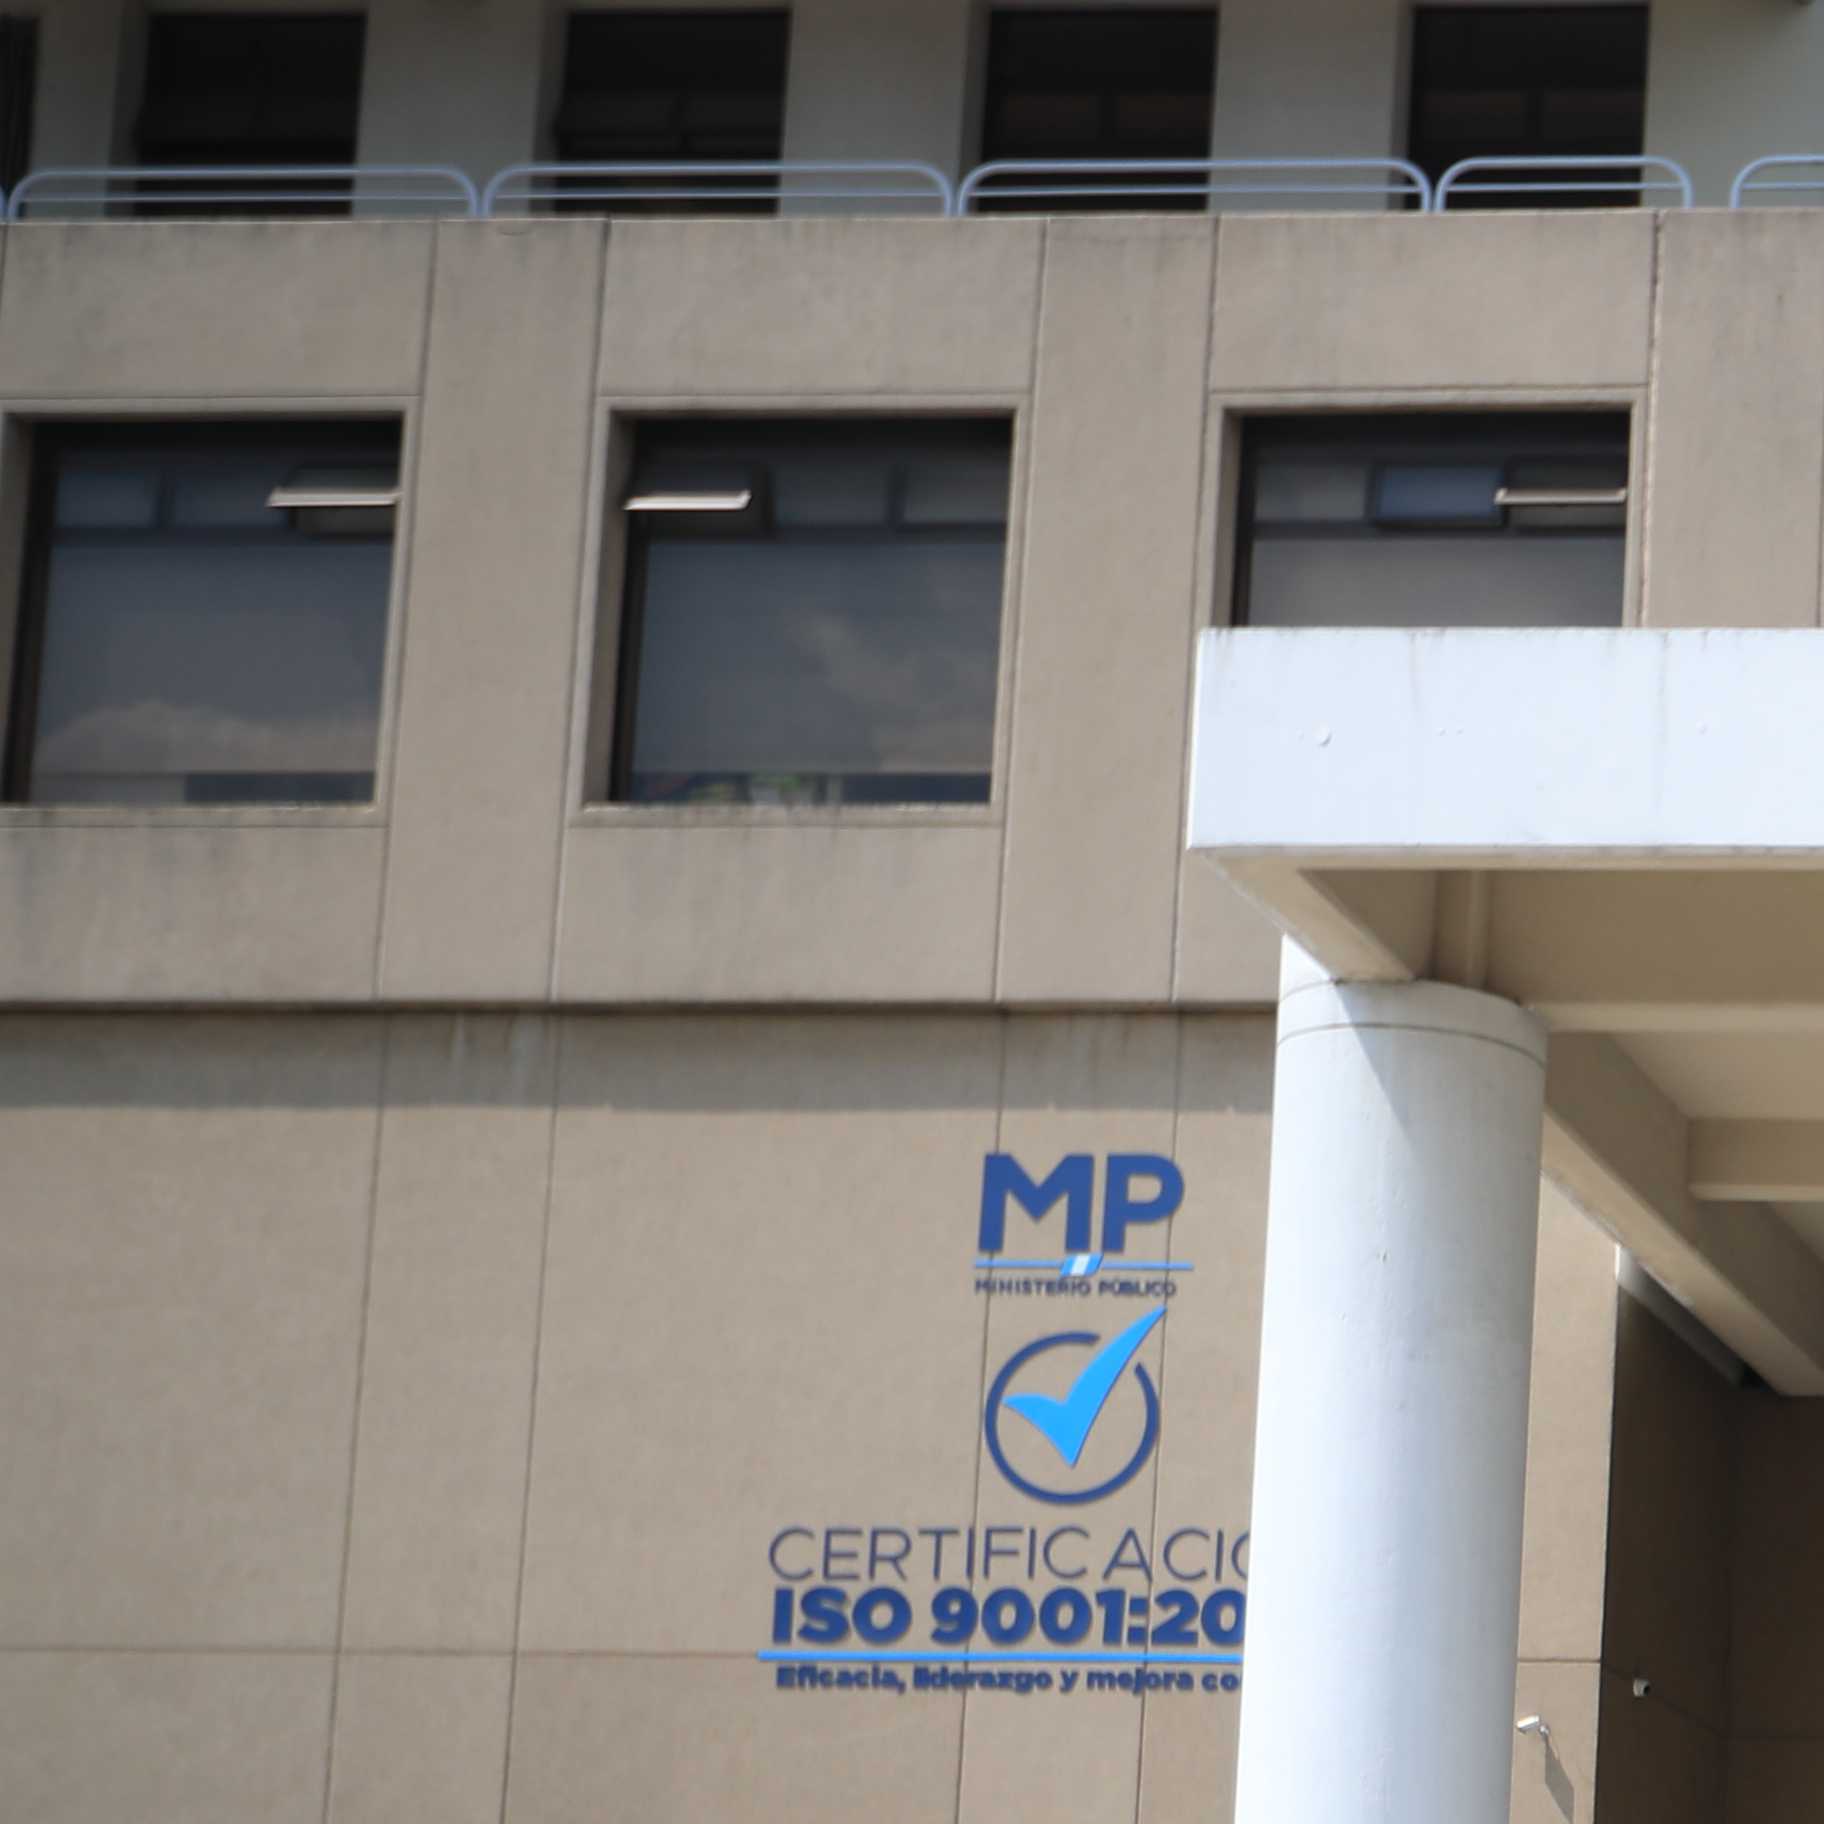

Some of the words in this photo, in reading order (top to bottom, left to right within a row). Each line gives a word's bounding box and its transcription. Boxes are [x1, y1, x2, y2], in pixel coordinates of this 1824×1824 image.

[978, 1153, 1186, 1252] MP
[975, 1278, 1091, 1296] MINISTERIO
[769, 1526, 1250, 1582] CERTIFICACI
[771, 1586, 913, 1646] ISO
[930, 1586, 1245, 1647] 9001:20
[776, 1665, 906, 1695] Eficacia,
[913, 1666, 1053, 1695] liderazgo
[1060, 1669, 1081, 1693] y
[1086, 1667, 1194, 1696] mejora
